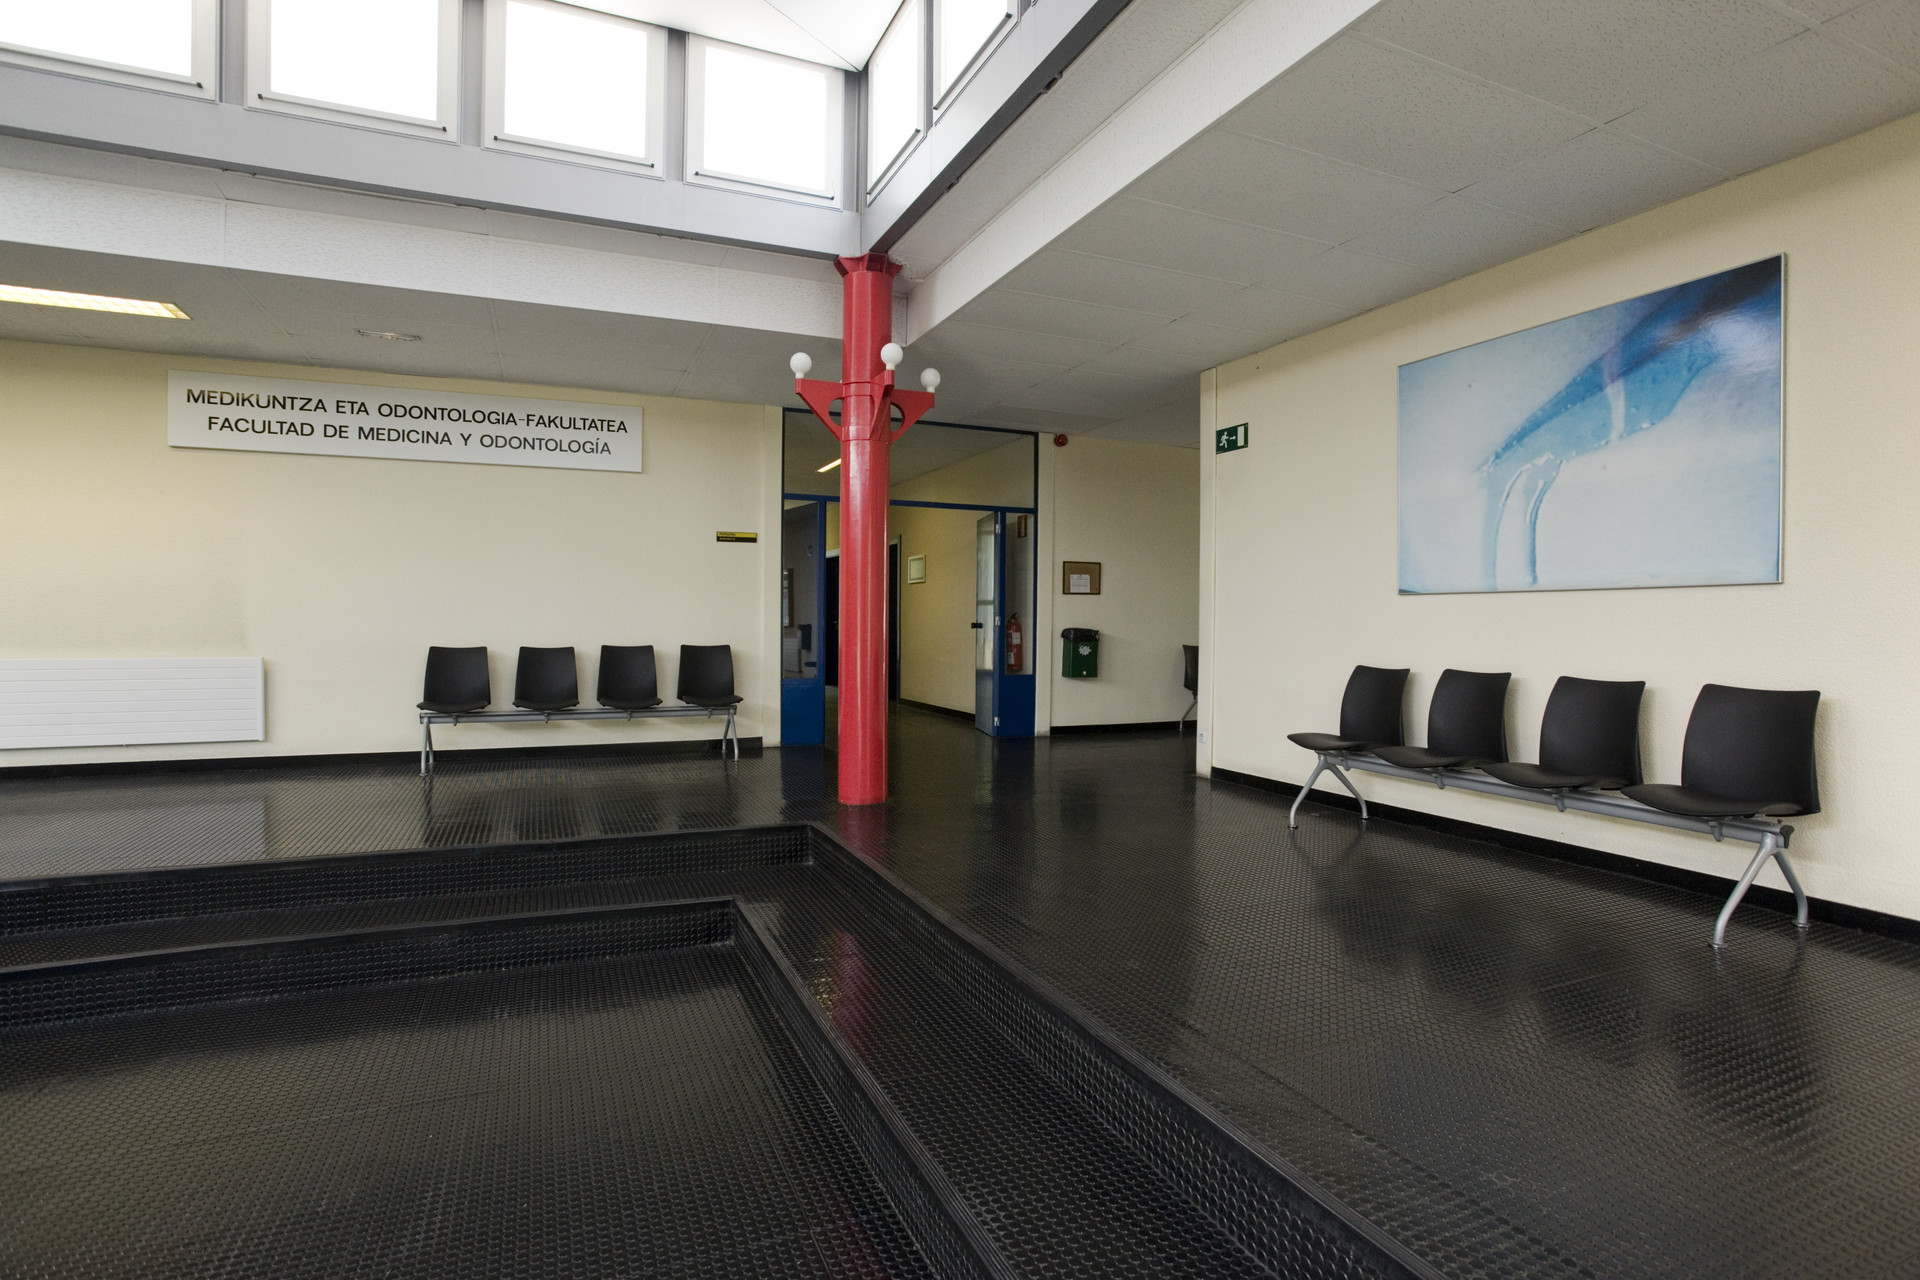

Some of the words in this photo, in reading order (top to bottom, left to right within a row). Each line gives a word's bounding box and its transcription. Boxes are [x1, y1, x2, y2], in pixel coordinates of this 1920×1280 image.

[186, 388, 328, 413] MEDIKUNTZA
[335, 399, 370, 416] ETA
[377, 402, 628, 434] ODONTOLOGIA-FAKULTATEA
[208, 415, 315, 437] FACULTAD
[323, 423, 350, 440] DE
[357, 425, 453, 446] MEDICINA
[459, 432, 473, 447] Y
[479, 433, 612, 455] ODONTOLOGÍA
